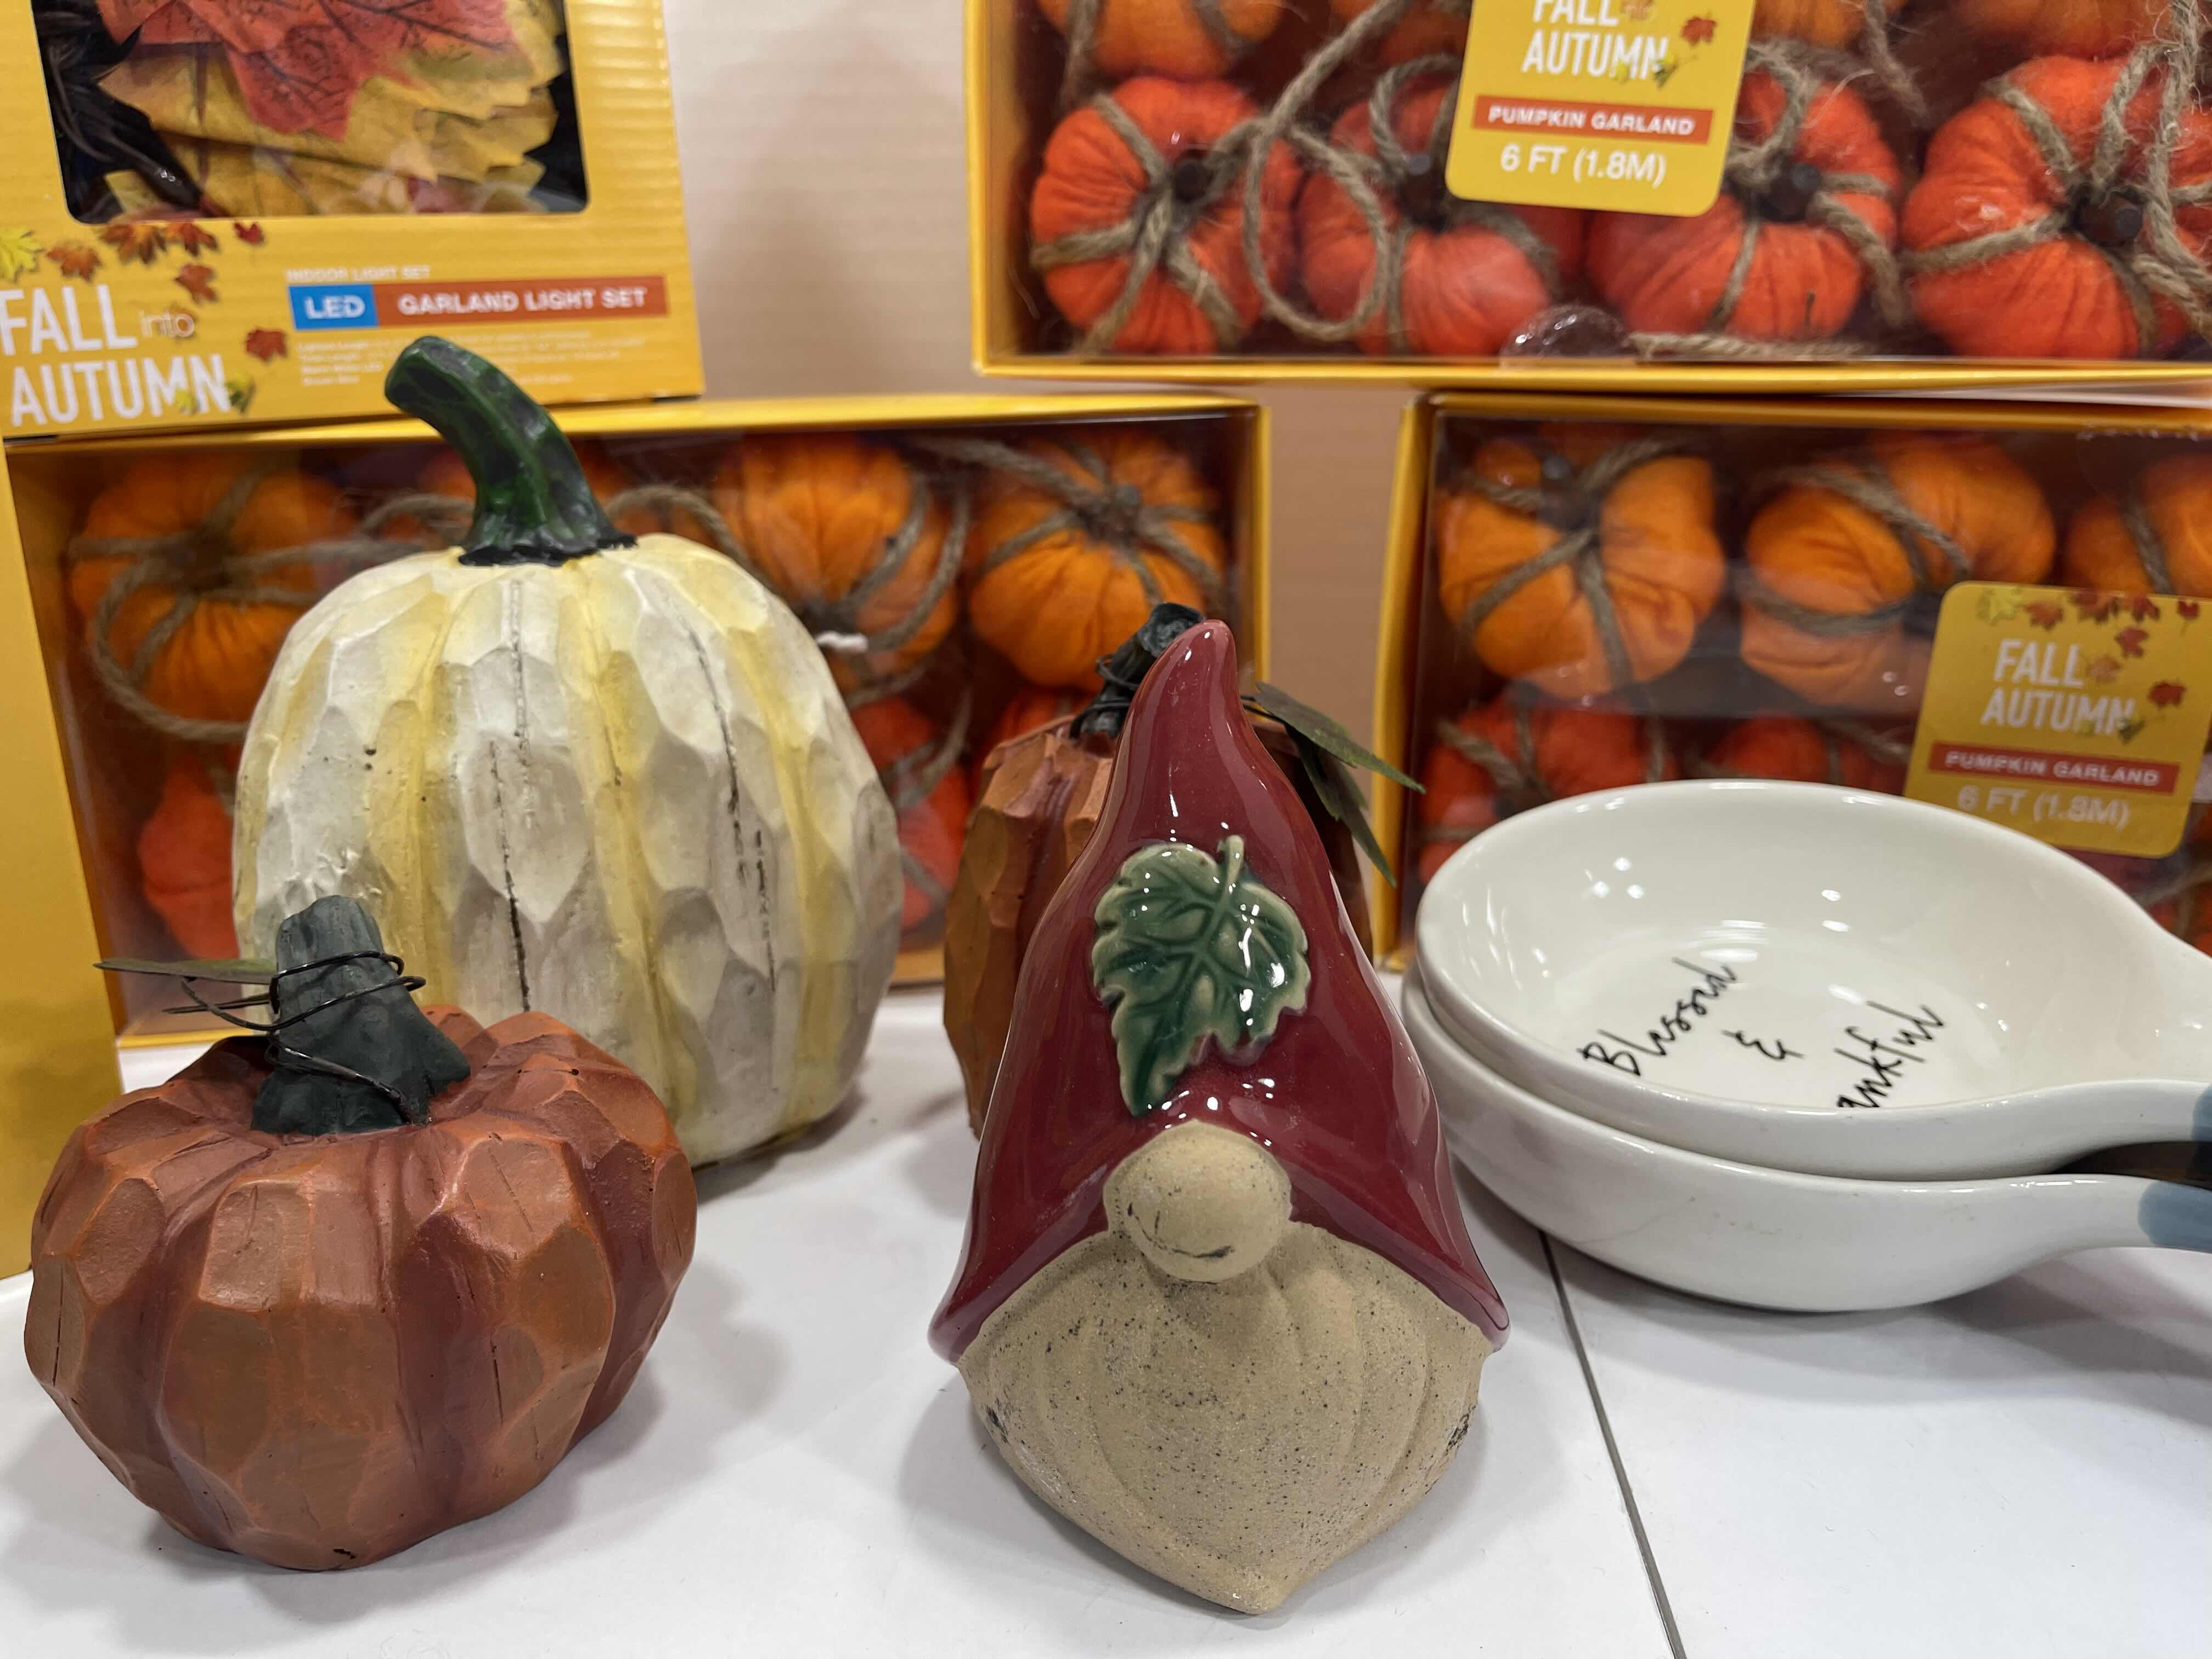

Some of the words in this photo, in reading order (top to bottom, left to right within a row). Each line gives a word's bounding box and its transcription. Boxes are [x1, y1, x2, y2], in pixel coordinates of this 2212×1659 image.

[1521, 30, 1671, 80] AUTUMN
[1488, 105, 1585, 129] PUMPKIN
[1592, 112, 1695, 136] GARLAND
[1500, 144, 1521, 172] 6
[1528, 145, 1567, 174] FT
[1573, 148, 1667, 189] (1.8M)
[0, 284, 138, 356] FALL
[139, 309, 195, 338] into
[304, 294, 365, 319] LED
[397, 290, 519, 316] GARLAND
[523, 287, 596, 312] LIGHT
[601, 286, 648, 309] SET
[11, 353, 232, 427] AUTUMN
[1993, 639, 2085, 689] FALL
[1980, 689, 2136, 737] AUTUMN
[1945, 750, 2047, 776] PUMPKIN
[2053, 760, 2160, 786] GARLAND
[1957, 786, 1979, 811] 6
[1985, 787, 2027, 814] FT
[2033, 791, 2131, 831] (1.8M)
[1576, 957, 1737, 1076] Blessed
[1833, 1000, 1944, 1108] ankful
